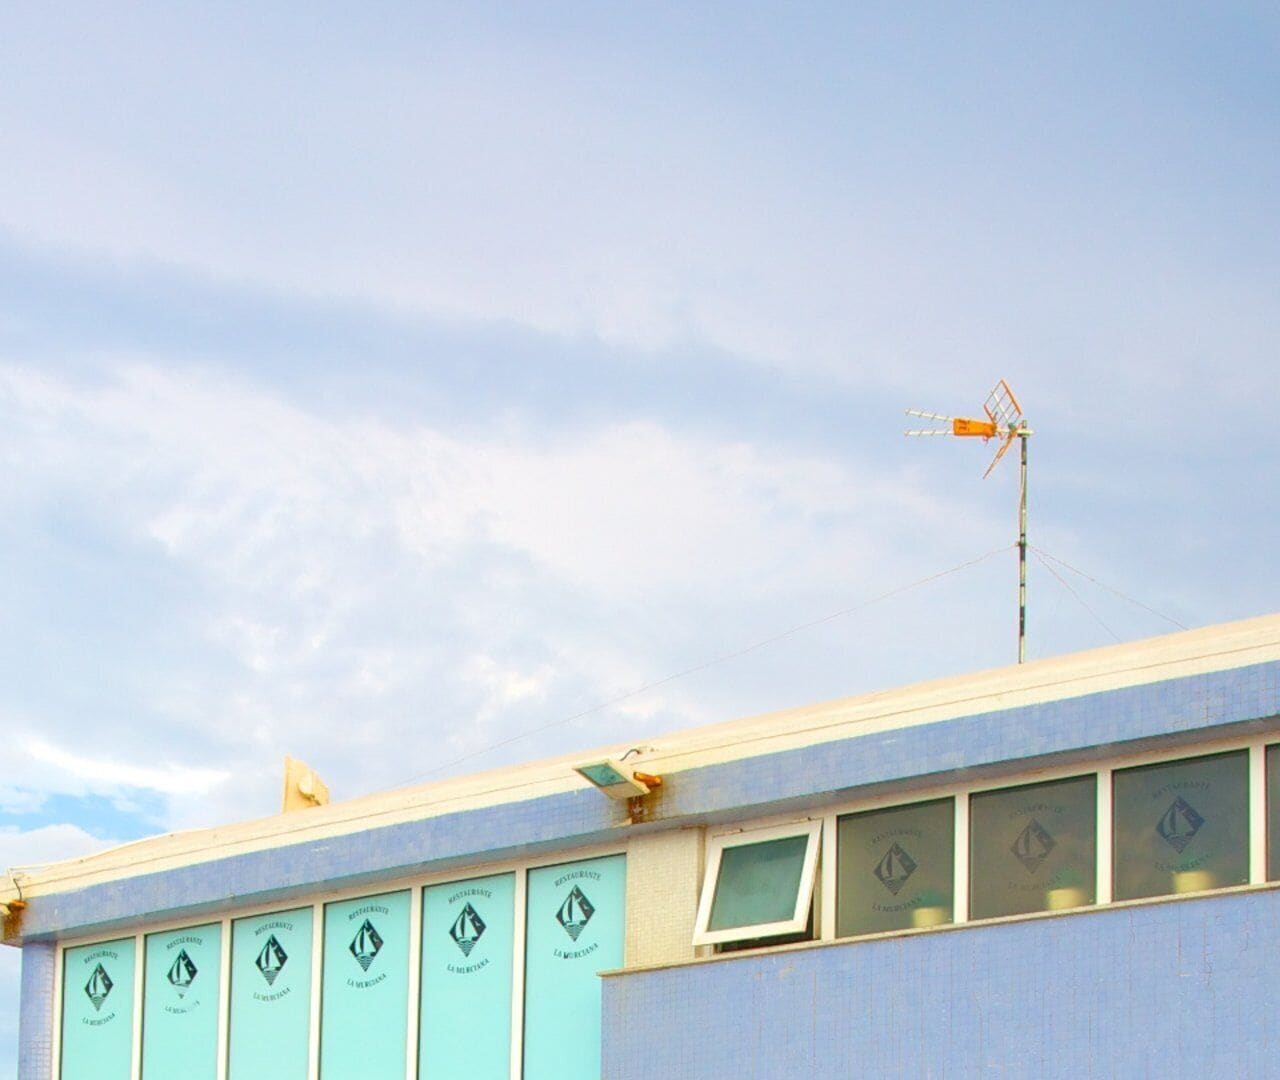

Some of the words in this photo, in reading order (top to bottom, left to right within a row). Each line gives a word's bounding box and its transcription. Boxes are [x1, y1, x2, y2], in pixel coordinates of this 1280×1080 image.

[554, 870, 602, 887] RESTAURANTE
[448, 888, 493, 904] RESTAURANTE
[348, 906, 389, 921] RESTAURANTE
[254, 921, 294, 936] RESTAURANTE
[166, 936, 203, 950] RESTAURANTE
[83, 950, 119, 964] RESTAURANTE
[553, 948, 563, 959] LA
[563, 942, 599, 960] MURCIANA
[447, 963, 455, 973] LA
[456, 958, 490, 974] MURCIANA
[346, 978, 353, 987] LA
[355, 972, 387, 989] MURCIANA
[253, 991, 261, 1000] LA
[261, 987, 291, 1002] MURCIANA
[82, 1017, 89, 1025] LA
[89, 1012, 116, 1026] MURCIANA
